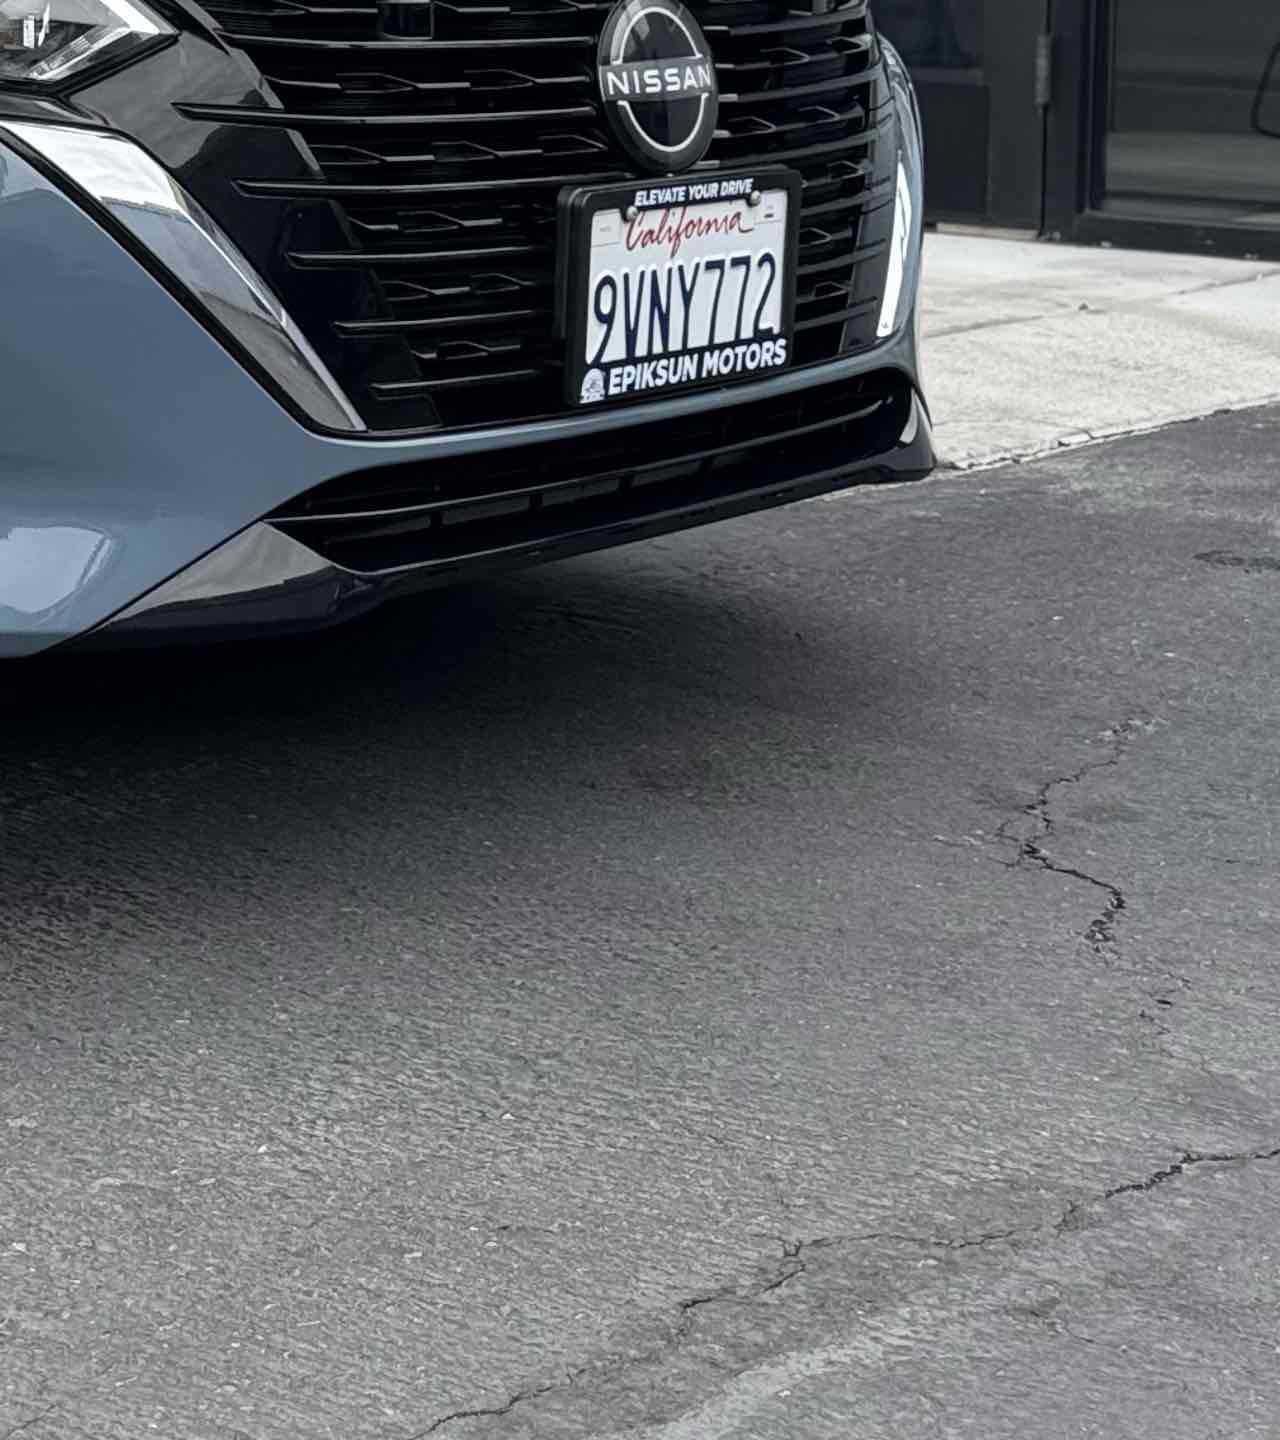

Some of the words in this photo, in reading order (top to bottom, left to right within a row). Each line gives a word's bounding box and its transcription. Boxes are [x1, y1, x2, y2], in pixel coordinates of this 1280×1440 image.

[606, 63, 712, 95] NISSAN
[634, 186, 688, 207] ELEVATE
[688, 182, 720, 200] YOUR
[720, 178, 755, 196] DRIVE
[625, 206, 755, 259] California
[590, 251, 777, 364] 9VNY772
[608, 352, 700, 397] EPIKSUN
[701, 338, 788, 379] MOTORS
